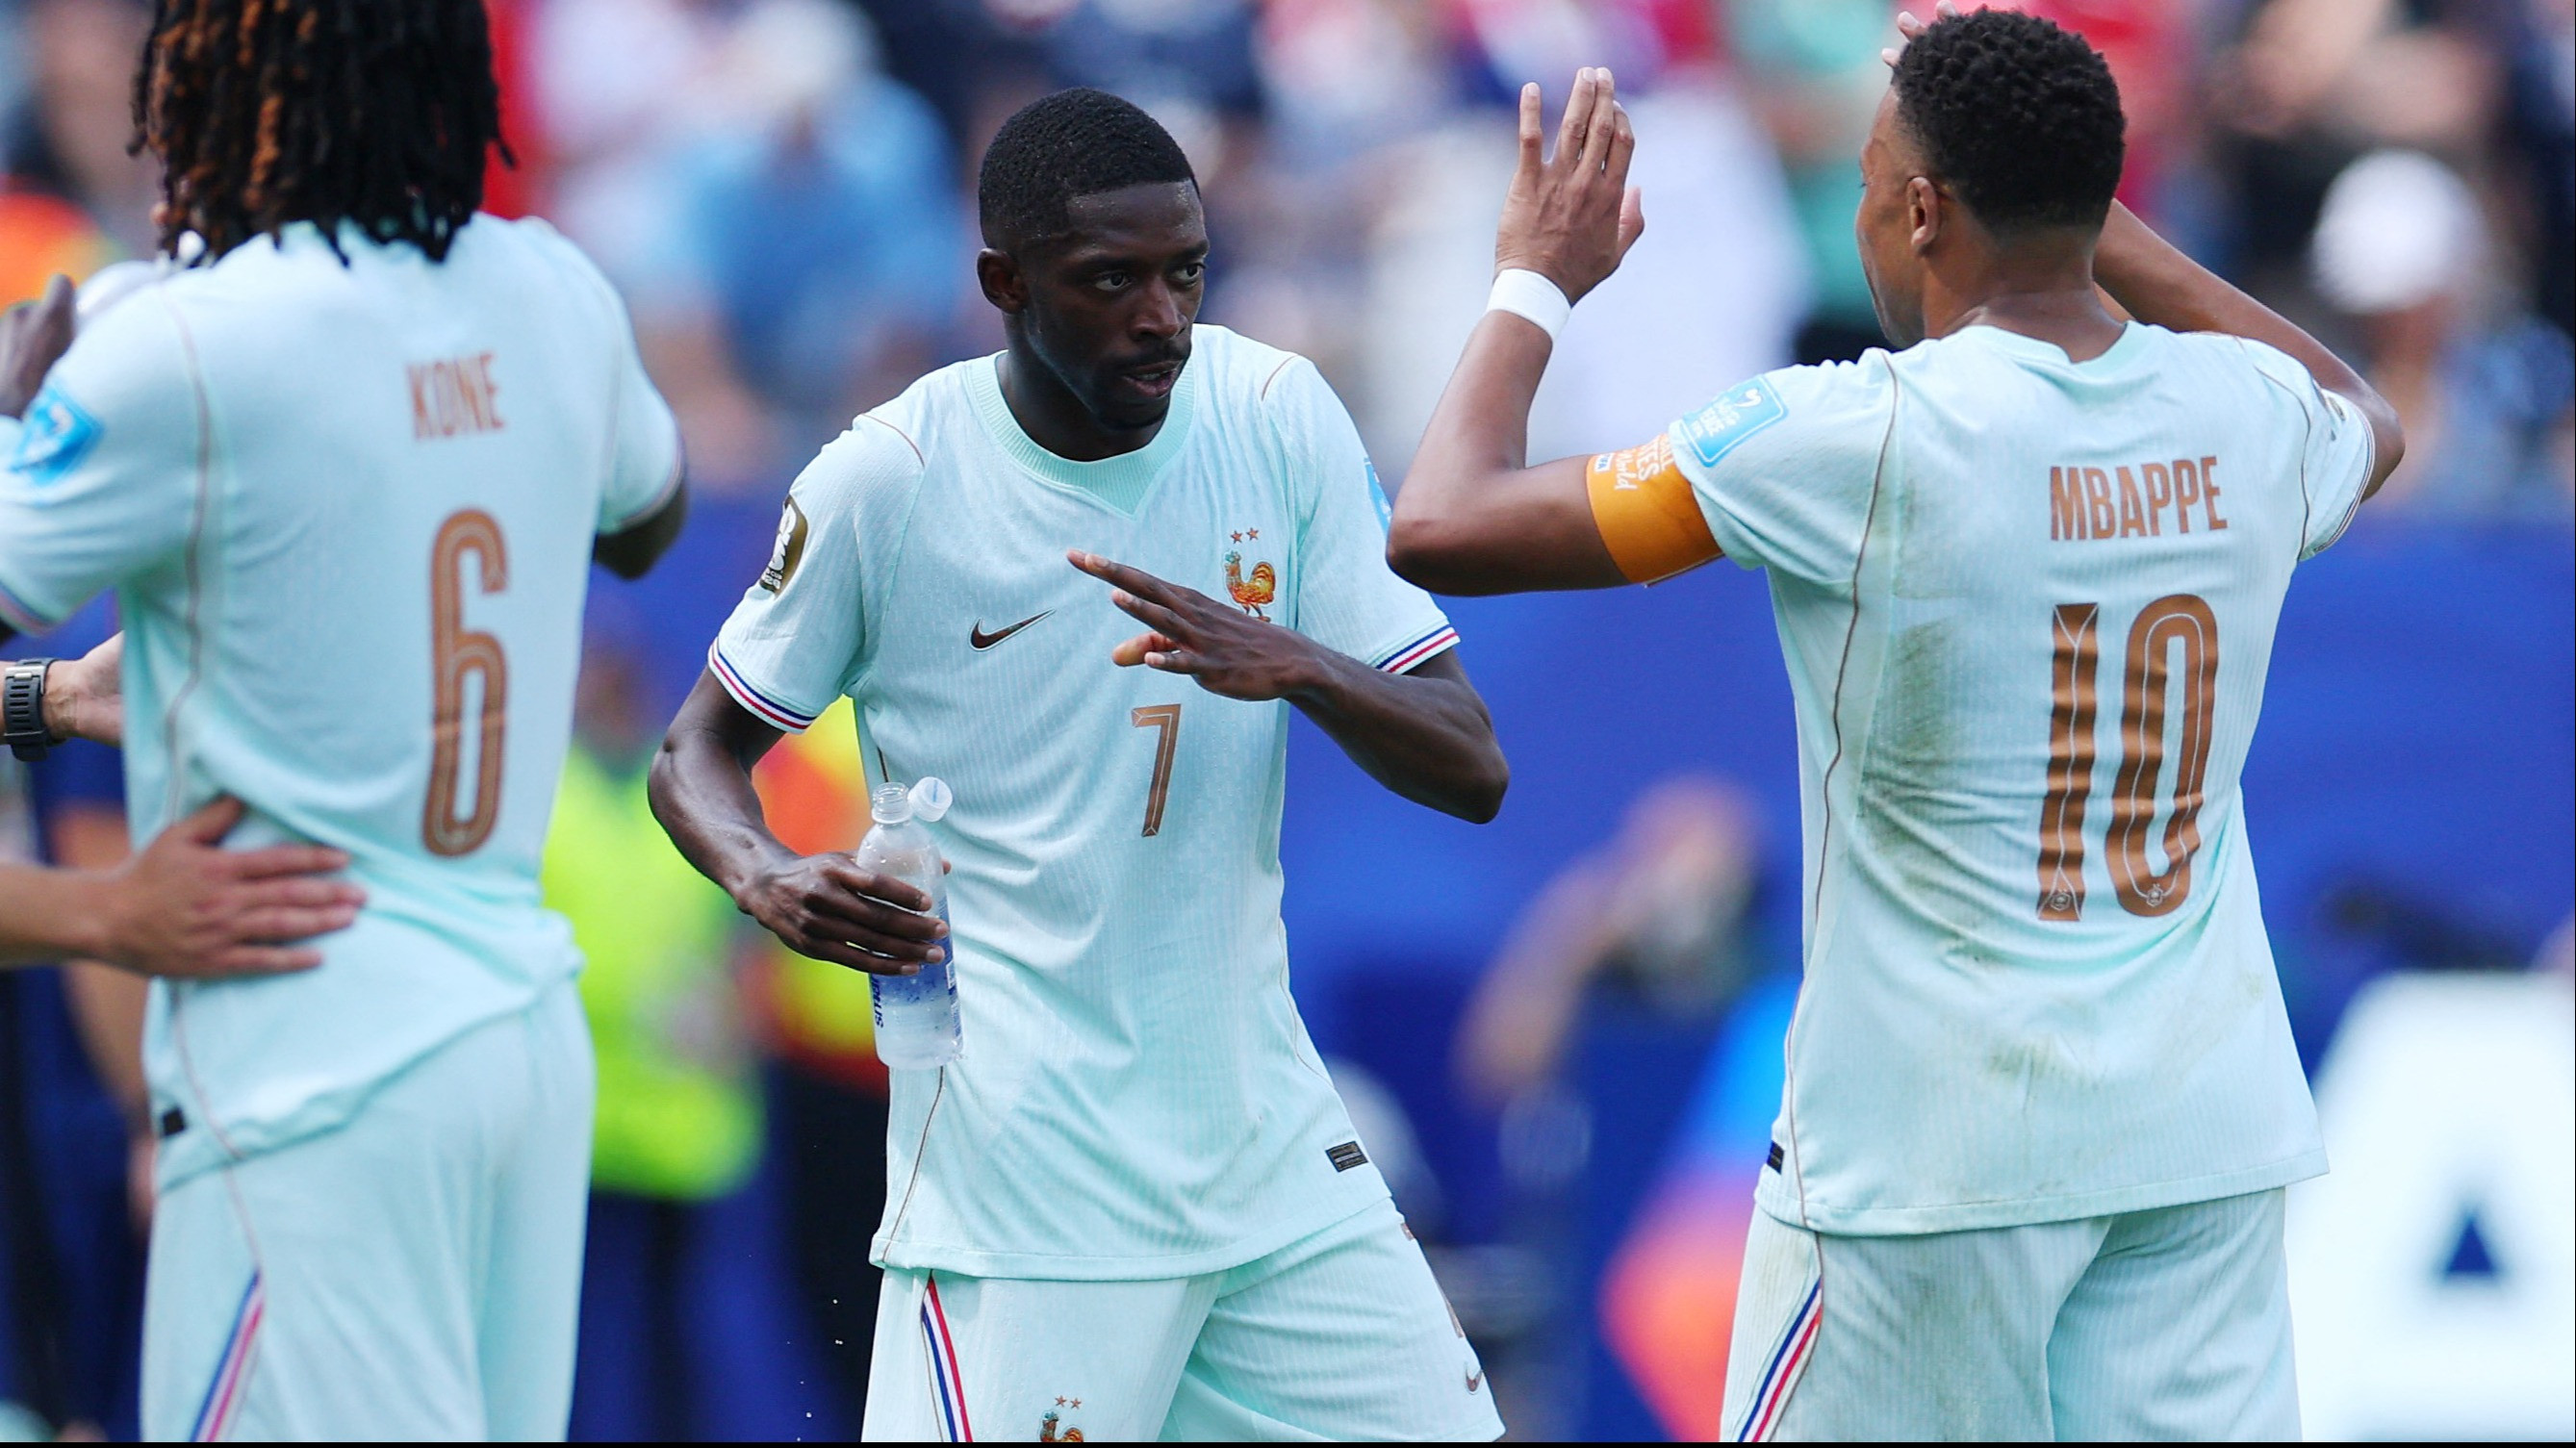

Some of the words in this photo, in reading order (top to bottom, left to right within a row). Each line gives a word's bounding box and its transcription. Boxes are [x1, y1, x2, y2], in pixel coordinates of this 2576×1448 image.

[406, 352, 504, 440] KONE
[2050, 456, 2228, 542] MBAPPE
[421, 507, 508, 857] 6
[1131, 703, 1182, 838] 7
[2037, 593, 2219, 922] 10
